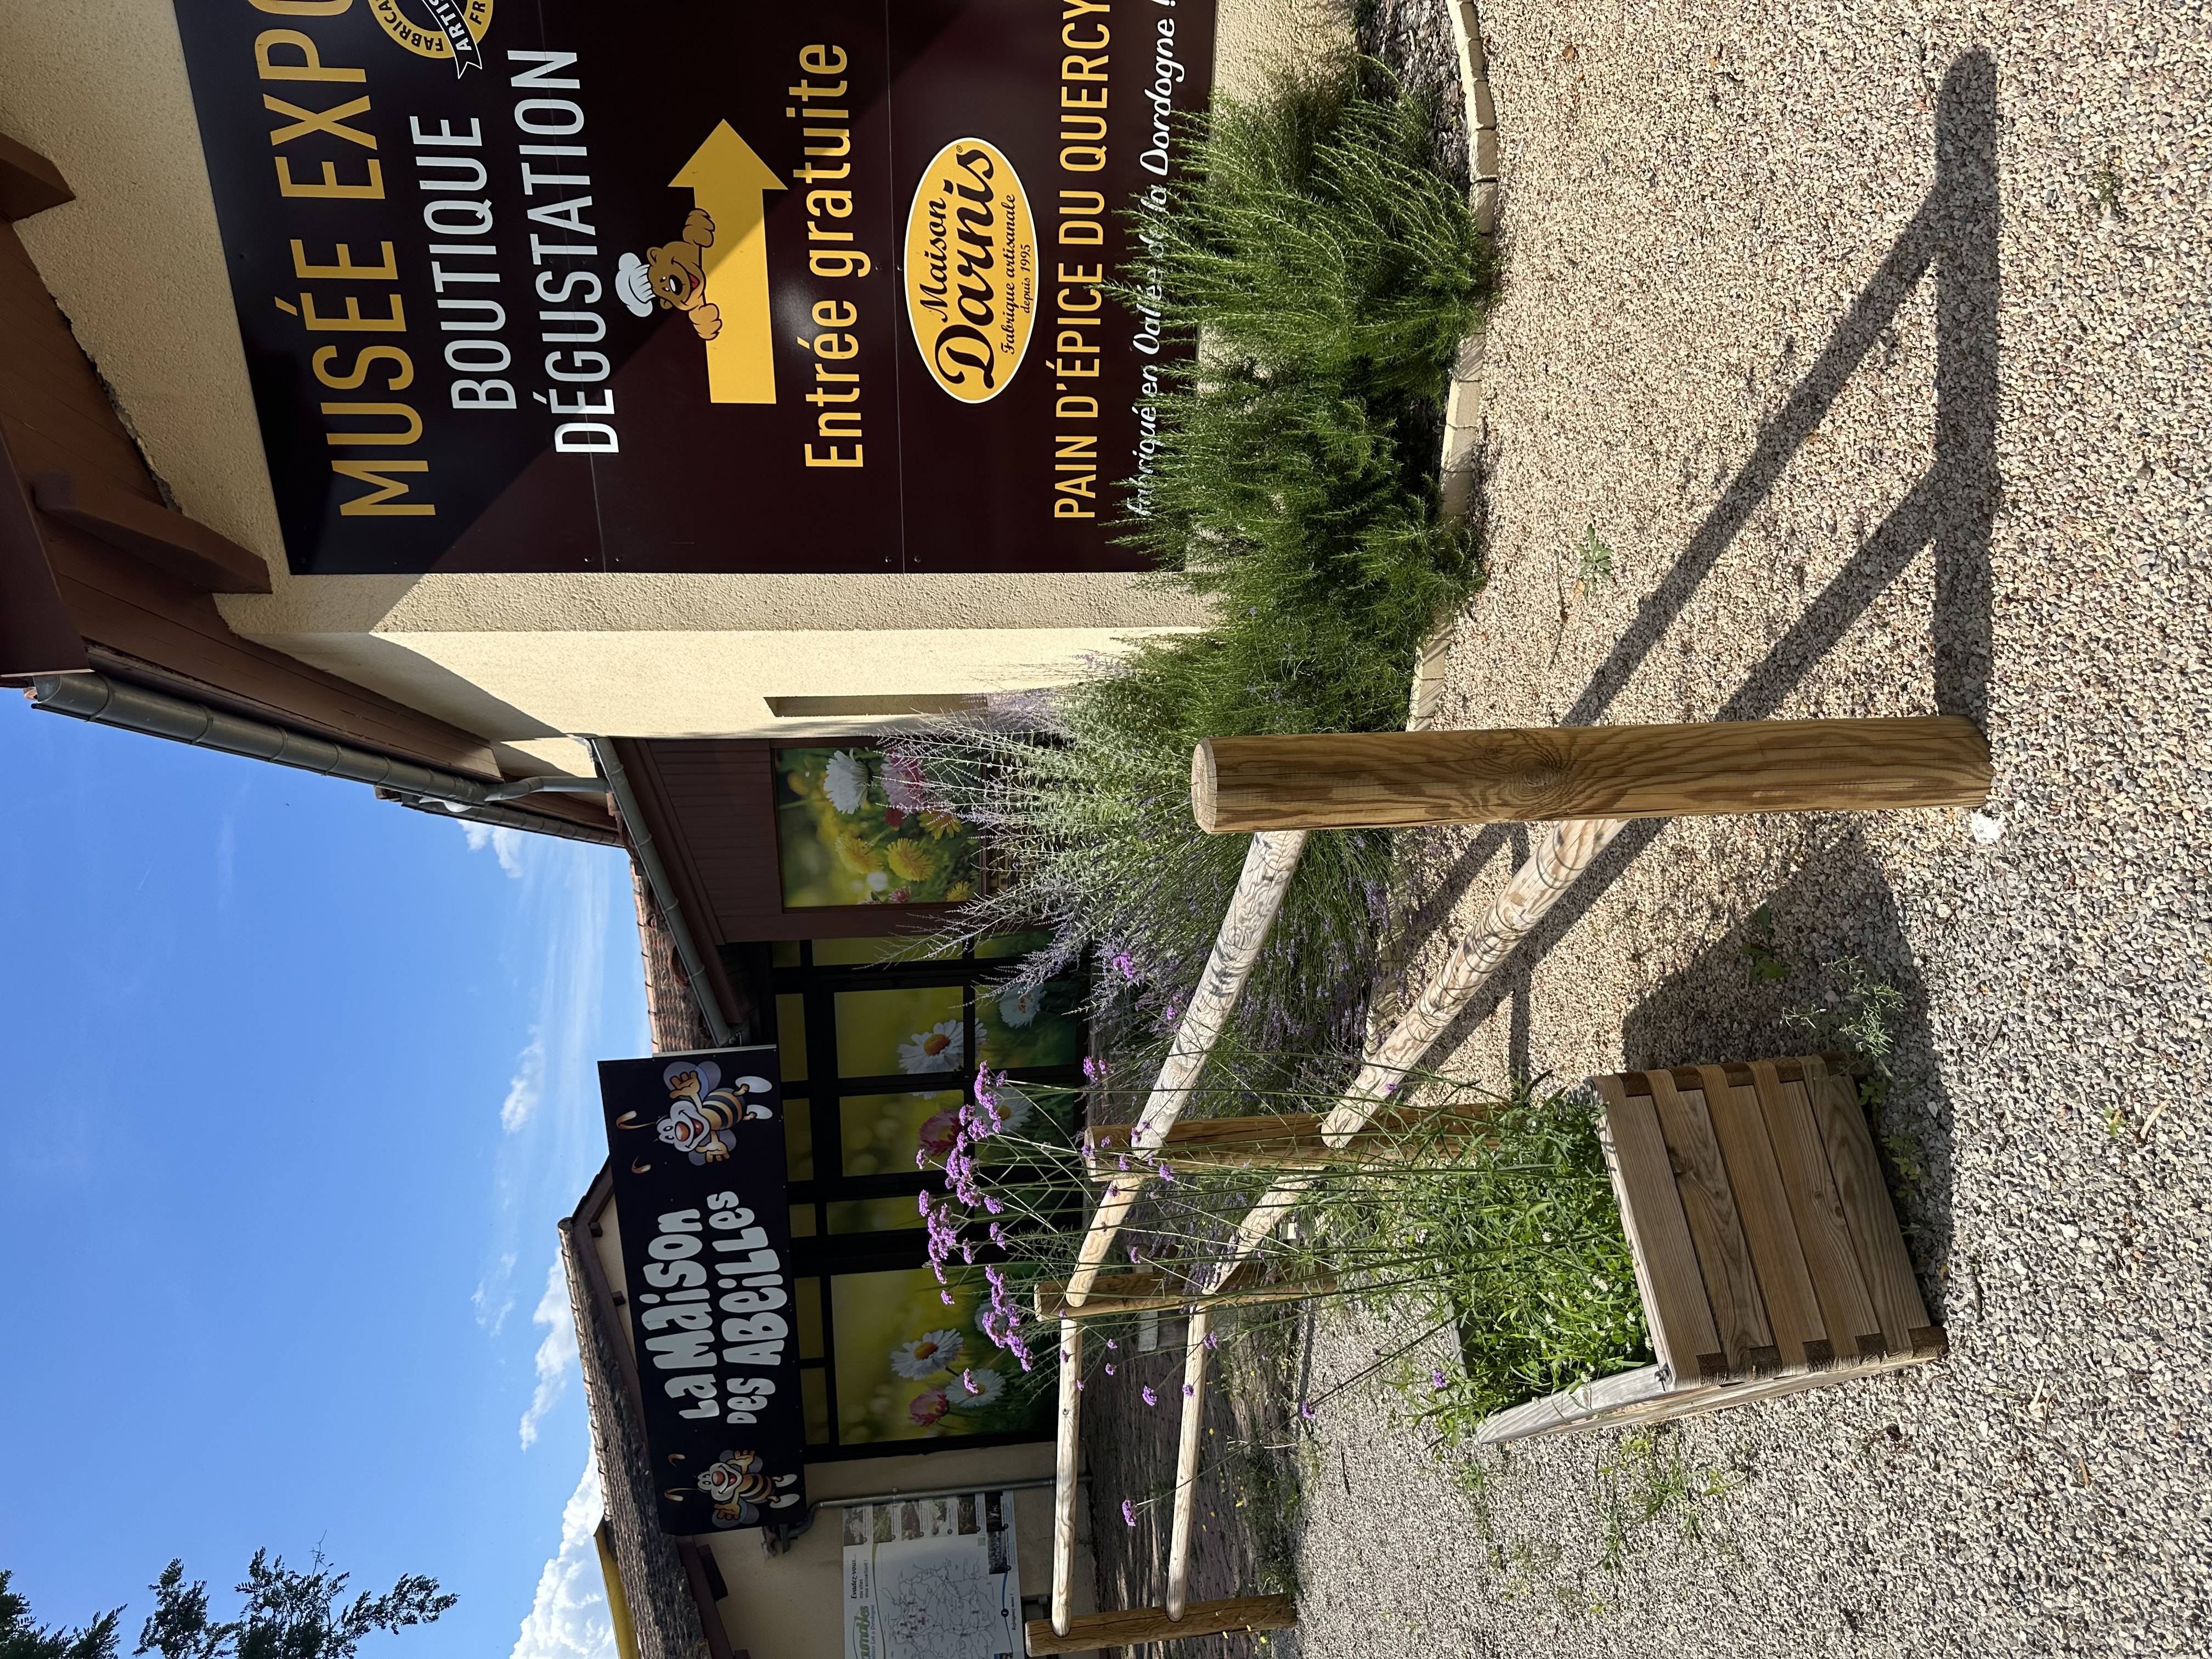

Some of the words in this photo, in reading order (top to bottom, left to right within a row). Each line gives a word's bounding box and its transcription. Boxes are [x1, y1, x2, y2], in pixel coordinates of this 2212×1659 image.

[375, 0, 443, 52] FABRICA
[1060, 0, 1110, 172] QUERCY
[1139, 18, 1184, 176] Dordogne
[786, 44, 871, 278] gratuite
[1141, 184, 1167, 212] la
[410, 116, 517, 409] BOUTIQUE
[507, 50, 619, 452] DÉGUSTATION
[919, 198, 948, 323] Maison
[1001, 194, 1015, 278] artisanale
[1020, 244, 1031, 272] 1995
[1059, 190, 1104, 245] DU
[1001, 282, 1019, 354] Fabrique
[1020, 277, 1033, 314] depuis
[1046, 263, 1103, 417] D'ÉPICE
[274, 239, 436, 516] MUSÉE
[797, 300, 863, 467] Entrée
[1142, 365, 1158, 397] en
[1054, 436, 1097, 518] PAIN
[639, 1209, 718, 1369] Maison
[664, 1374, 720, 1419] La
